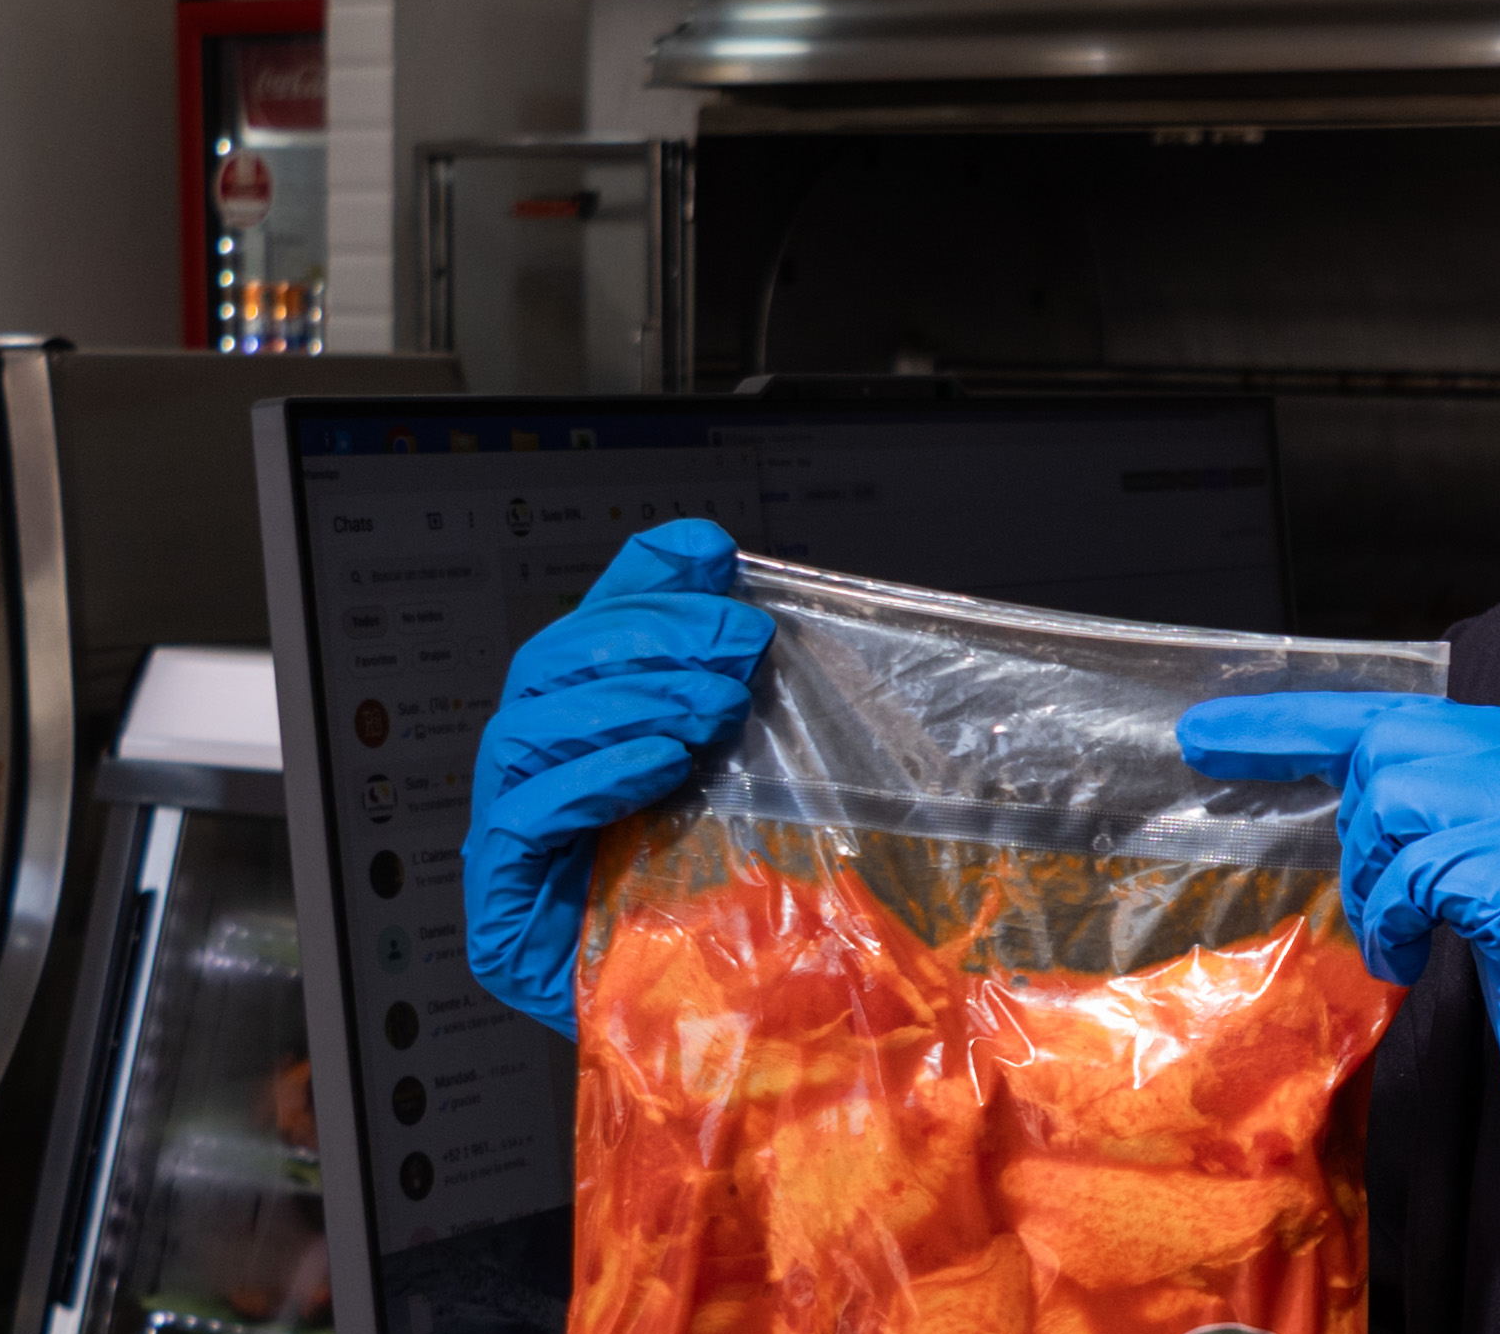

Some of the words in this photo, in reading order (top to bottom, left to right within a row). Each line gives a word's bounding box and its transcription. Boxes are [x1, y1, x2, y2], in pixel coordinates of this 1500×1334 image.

[333, 515, 374, 534] Chats
[352, 614, 380, 629] Todos
[355, 654, 397, 668] Favoritos
[419, 650, 452, 663] Grupos
